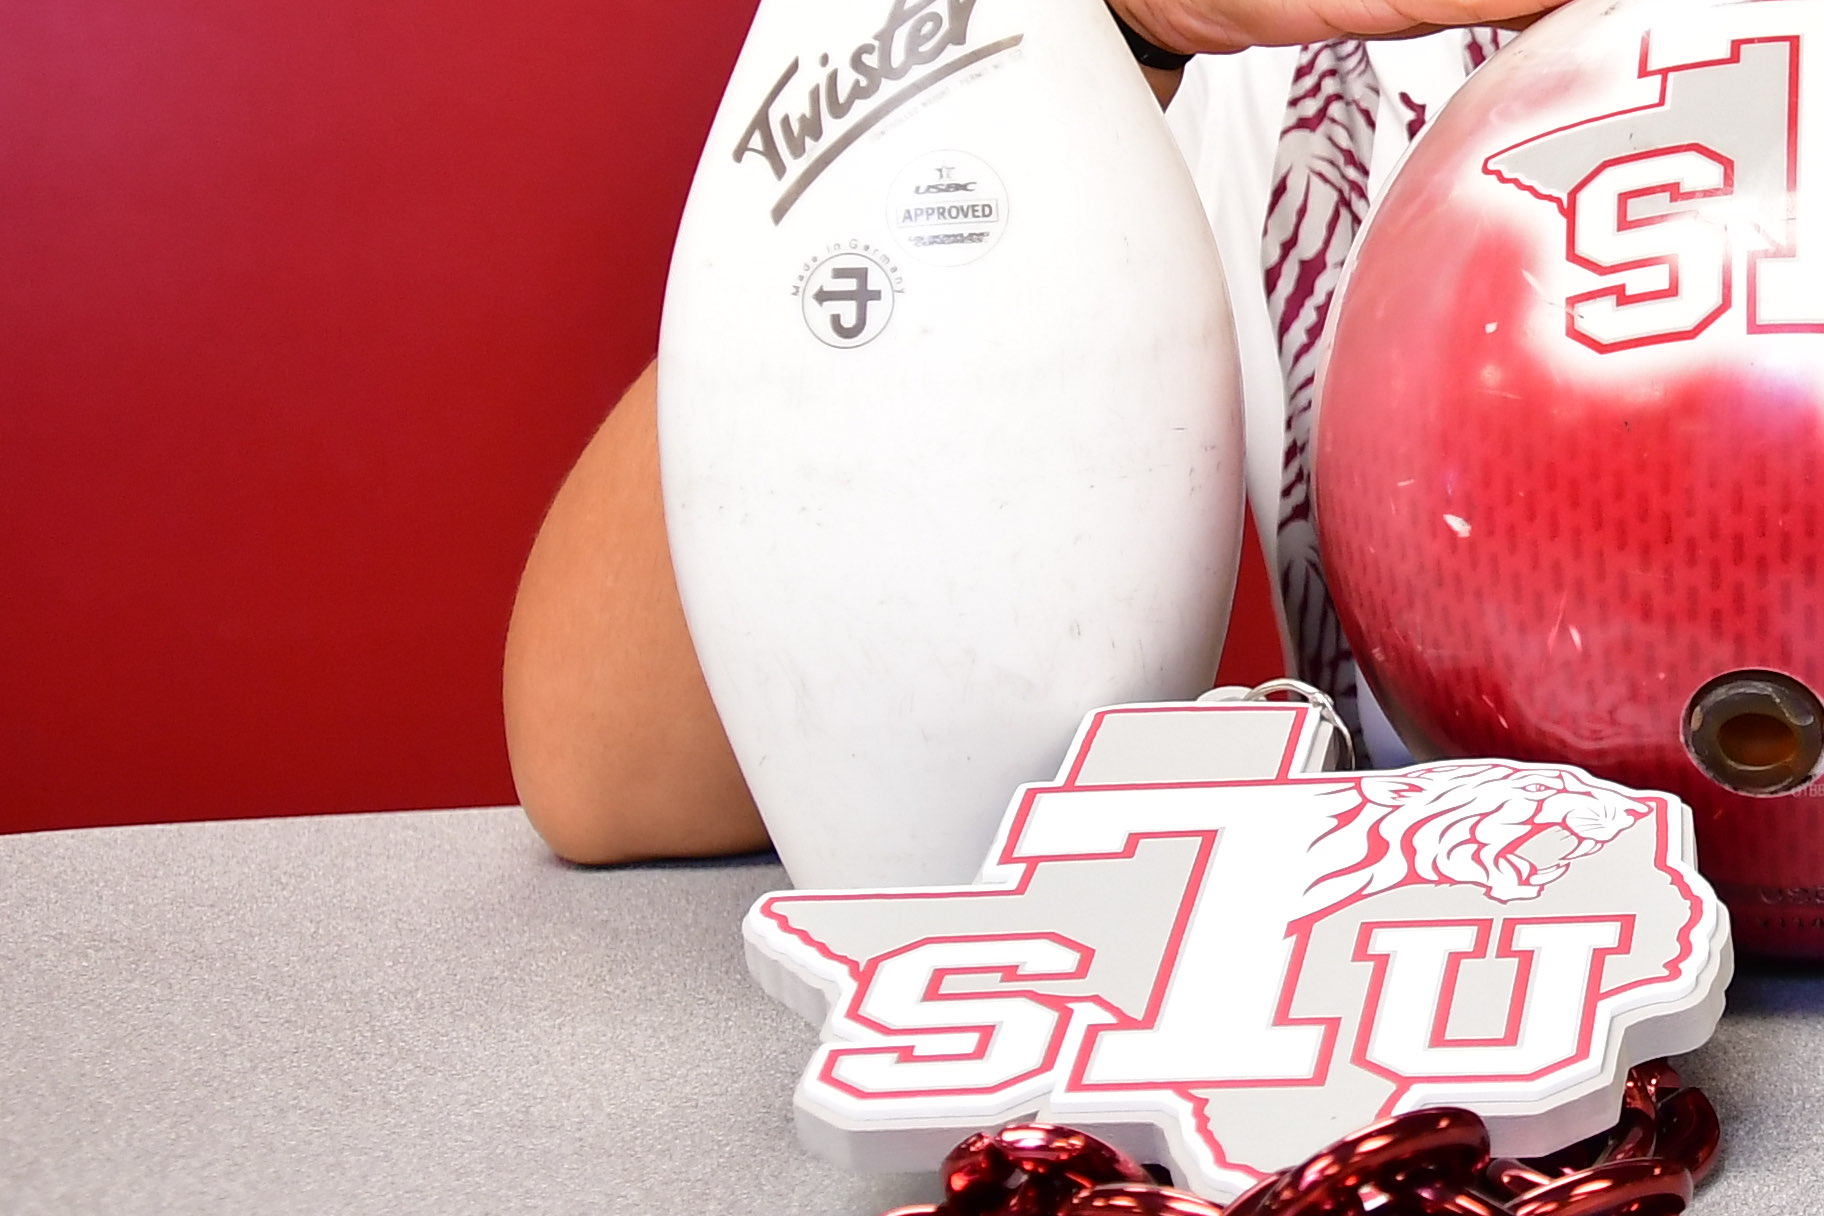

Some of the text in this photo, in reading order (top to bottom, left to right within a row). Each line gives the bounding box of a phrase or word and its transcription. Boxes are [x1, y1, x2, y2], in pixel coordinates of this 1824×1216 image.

[902, 203, 993, 224] APPROVED
[790, 238, 906, 297] Made in Germany
